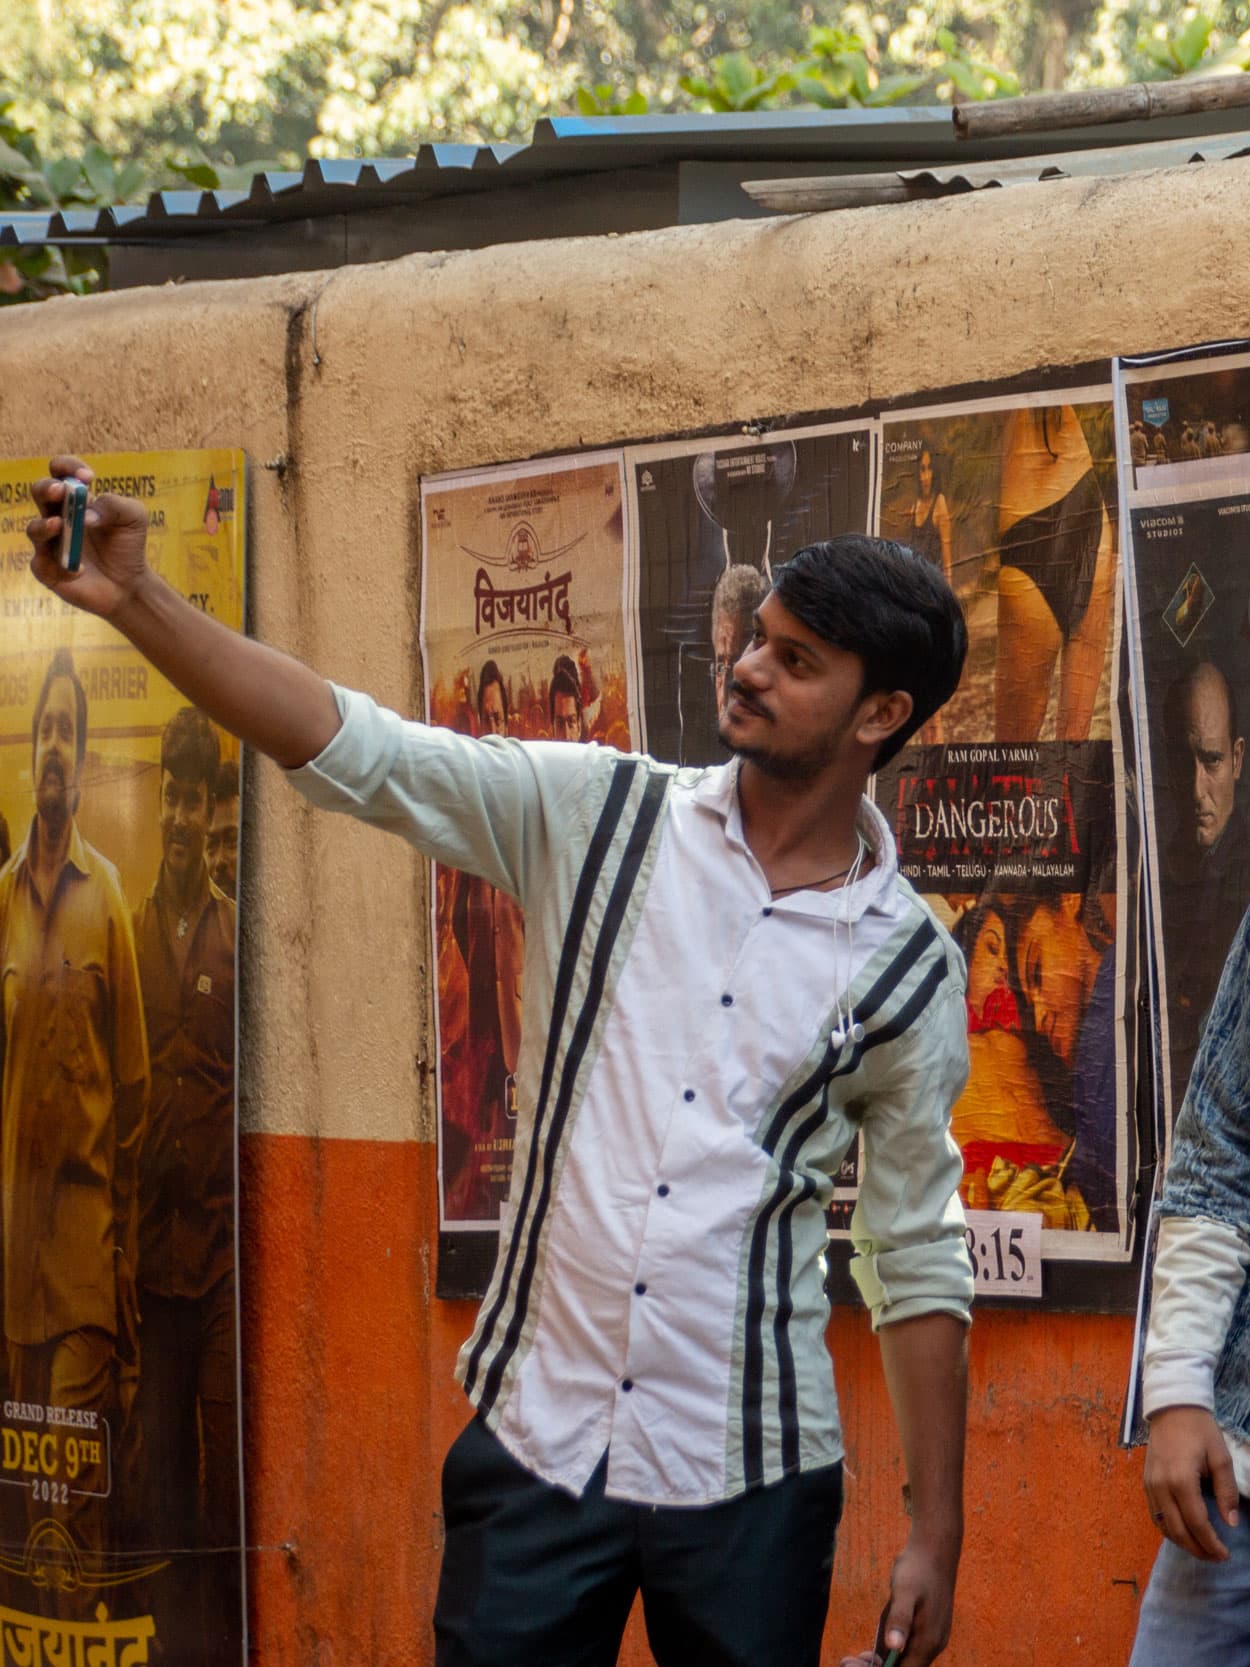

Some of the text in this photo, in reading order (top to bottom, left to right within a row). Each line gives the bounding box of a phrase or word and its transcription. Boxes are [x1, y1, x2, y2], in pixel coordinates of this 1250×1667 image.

[95, 475, 156, 497] PRESENTS
[474, 567, 572, 635] विजयानंद
[948, 750, 969, 763] RAM
[970, 749, 1000, 762] GOPAL
[915, 795, 1059, 839] DANGEROUS
[900, 864, 1075, 877] HINDI TAMIL TELUGU KANNADA MALAYALAM
[4, 1401, 98, 1430] GRAND RELEASE
[1, 1428, 102, 1480] DEC 9TH
[31, 1479, 69, 1504] 2022
